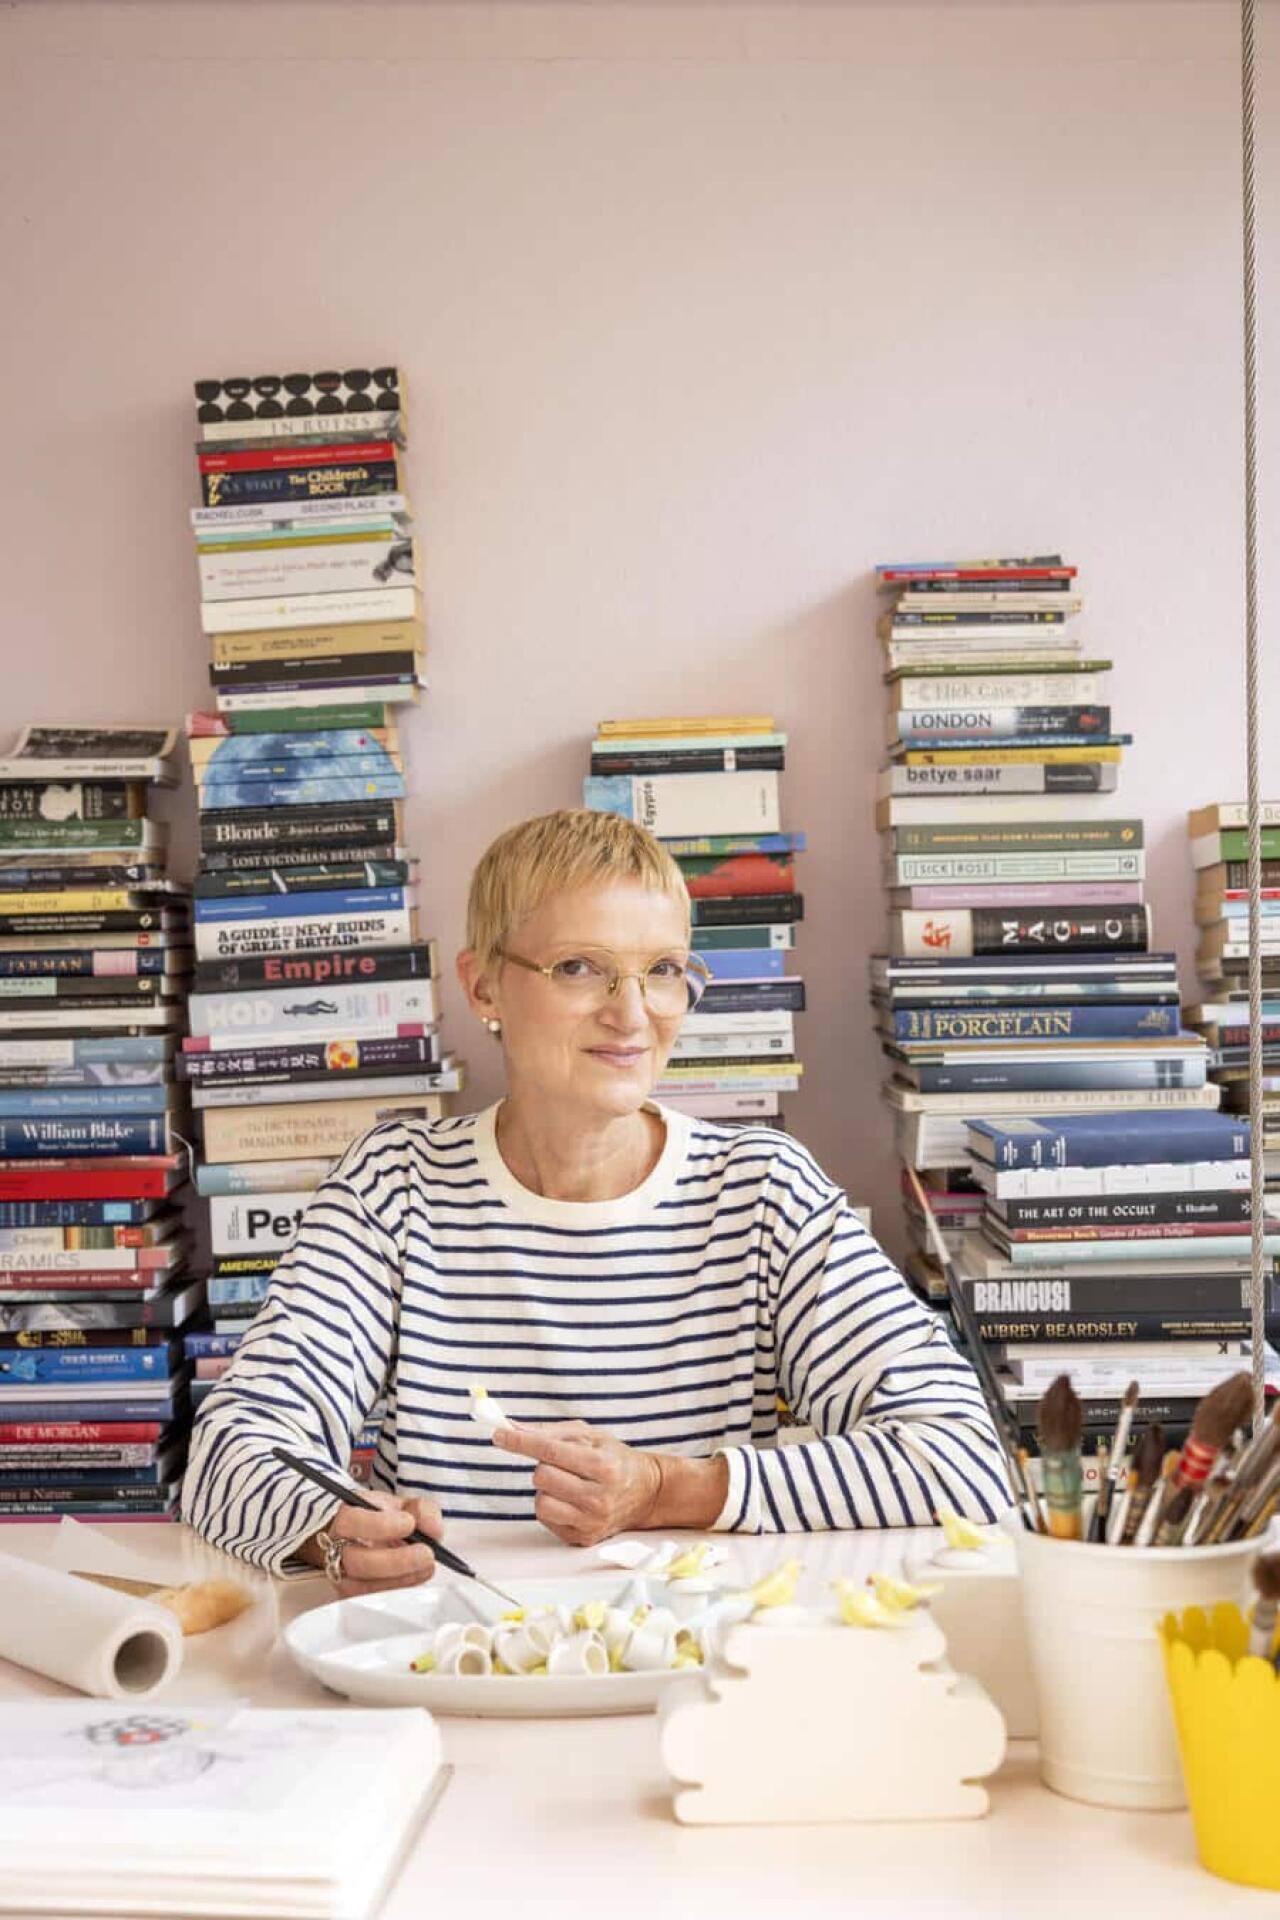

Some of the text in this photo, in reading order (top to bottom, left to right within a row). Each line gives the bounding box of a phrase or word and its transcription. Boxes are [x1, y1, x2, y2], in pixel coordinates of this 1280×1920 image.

[272, 415, 371, 435] IN RUINS
[345, 498, 376, 511] PLACE
[911, 713, 992, 730] LONDON
[907, 767, 1002, 785] betye saar
[215, 821, 279, 843] Blonde
[232, 849, 377, 867] LOST VICTORIAN BRITAIN
[919, 861, 990, 876] SICK ROSE
[218, 919, 385, 943] A GUIDE NEW RUINS
[218, 934, 360, 955] OF GREAT BRITAIN
[264, 953, 377, 982] Empire
[934, 1015, 1072, 1037] PORCELAIN
[22, 1120, 135, 1140] William Blake
[1018, 1208, 1038, 1219] THE
[1042, 1207, 1064, 1218] ART
[1068, 1206, 1084, 1218] OF
[1088, 1205, 1108, 1217] THE
[1112, 1205, 1156, 1217] OCCULT
[218, 1259, 279, 1272] AMERICAN
[973, 1280, 1071, 1312] BRANCUSI
[979, 1321, 1139, 1339] AUBREY BEARDSLEY
[16, 1425, 100, 1440] DE MORGAN
